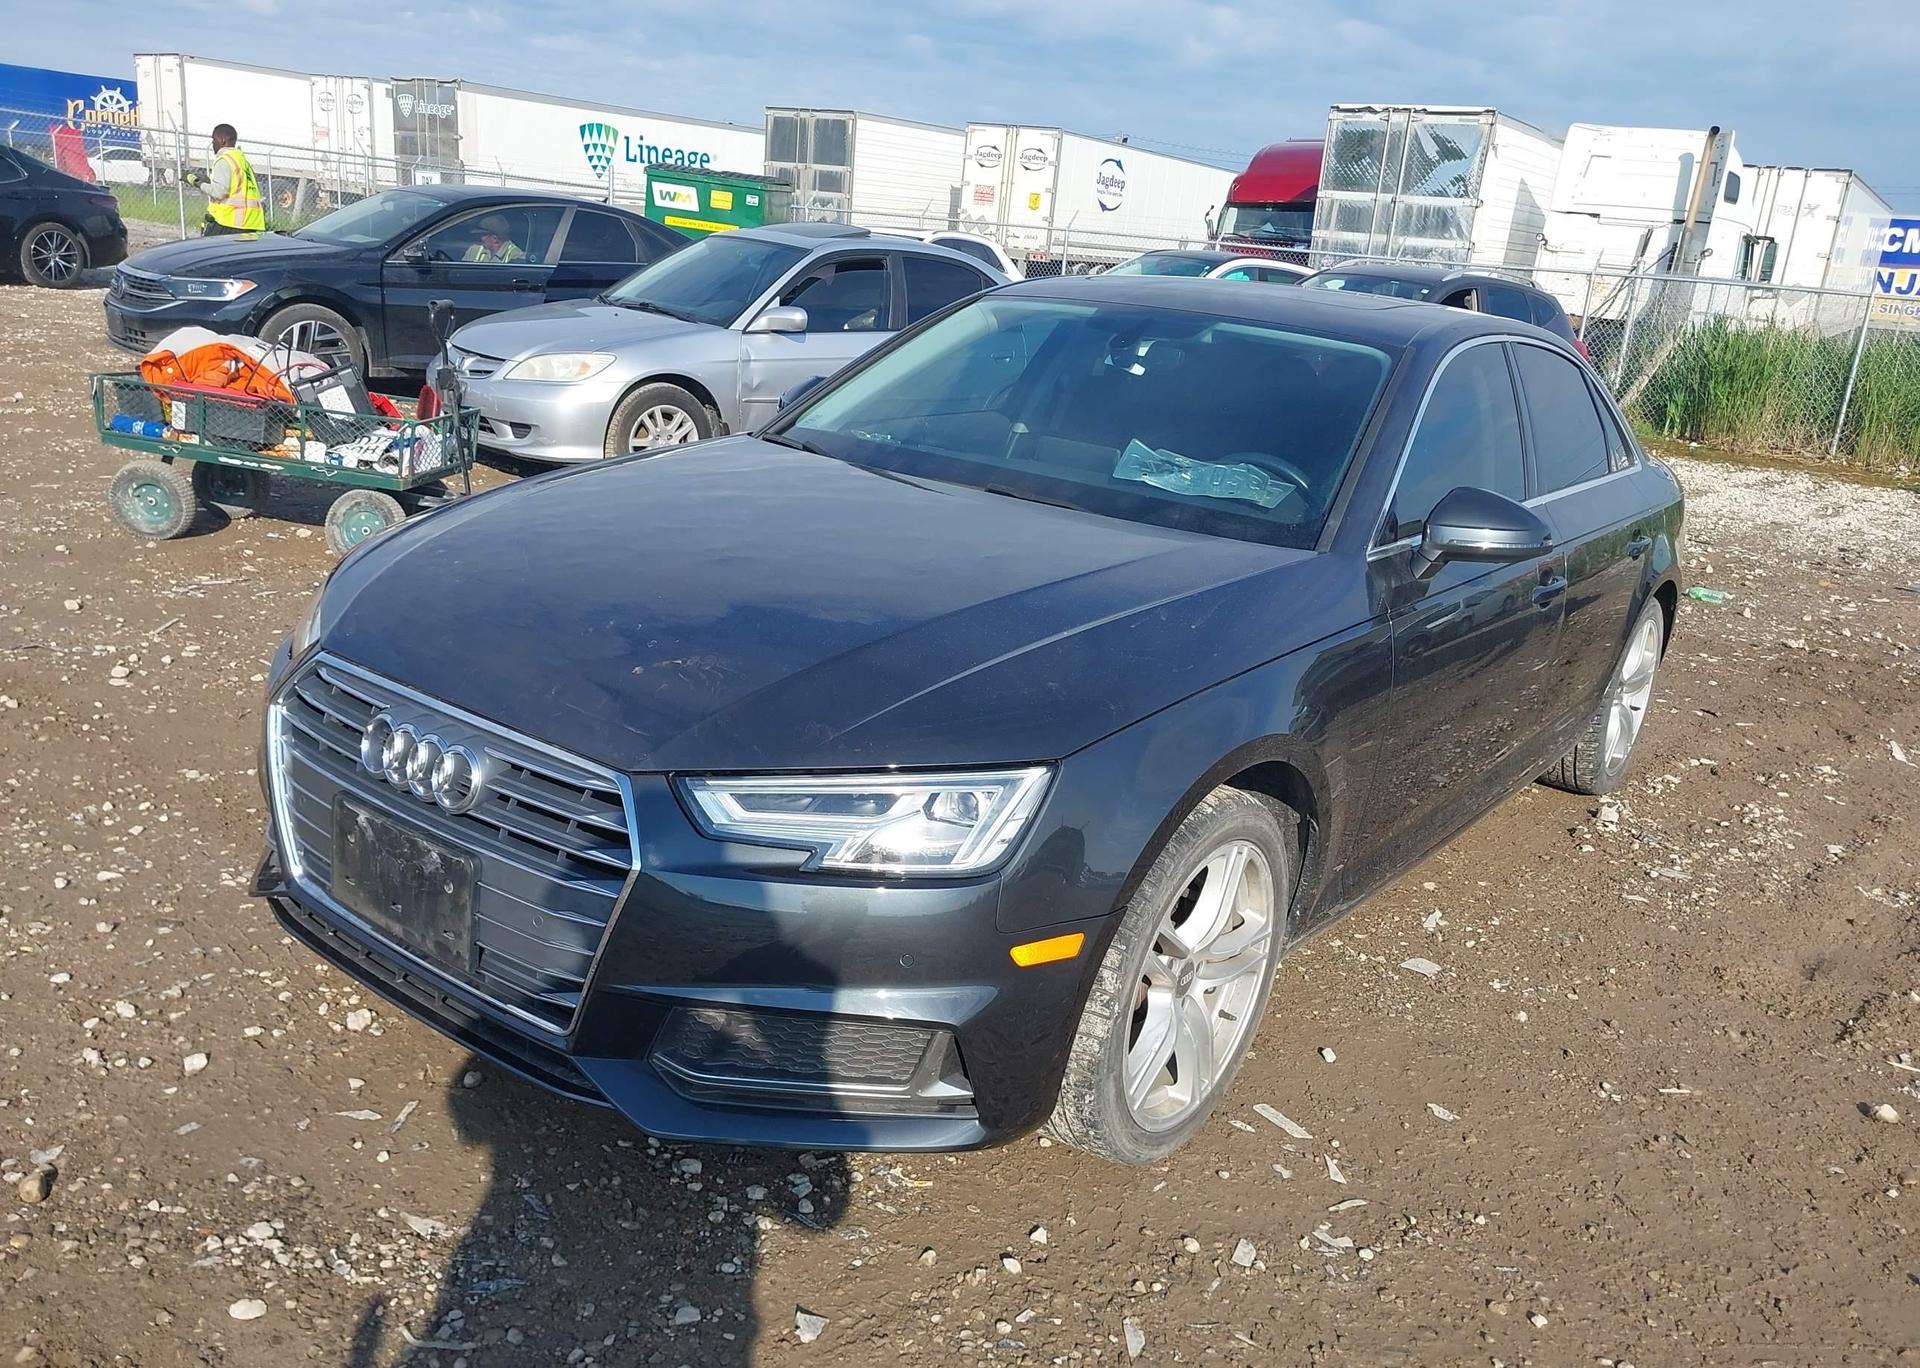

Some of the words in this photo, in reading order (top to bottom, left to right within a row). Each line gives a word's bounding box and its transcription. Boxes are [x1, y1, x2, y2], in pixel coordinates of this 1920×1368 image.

[413, 100, 451, 118] Lineage
[623, 135, 711, 168] Lineage
[974, 149, 1003, 160] Jagdeep
[1019, 152, 1049, 163] Jagdeep
[1096, 171, 1126, 192] Jagdeep
[659, 189, 692, 204] WM
